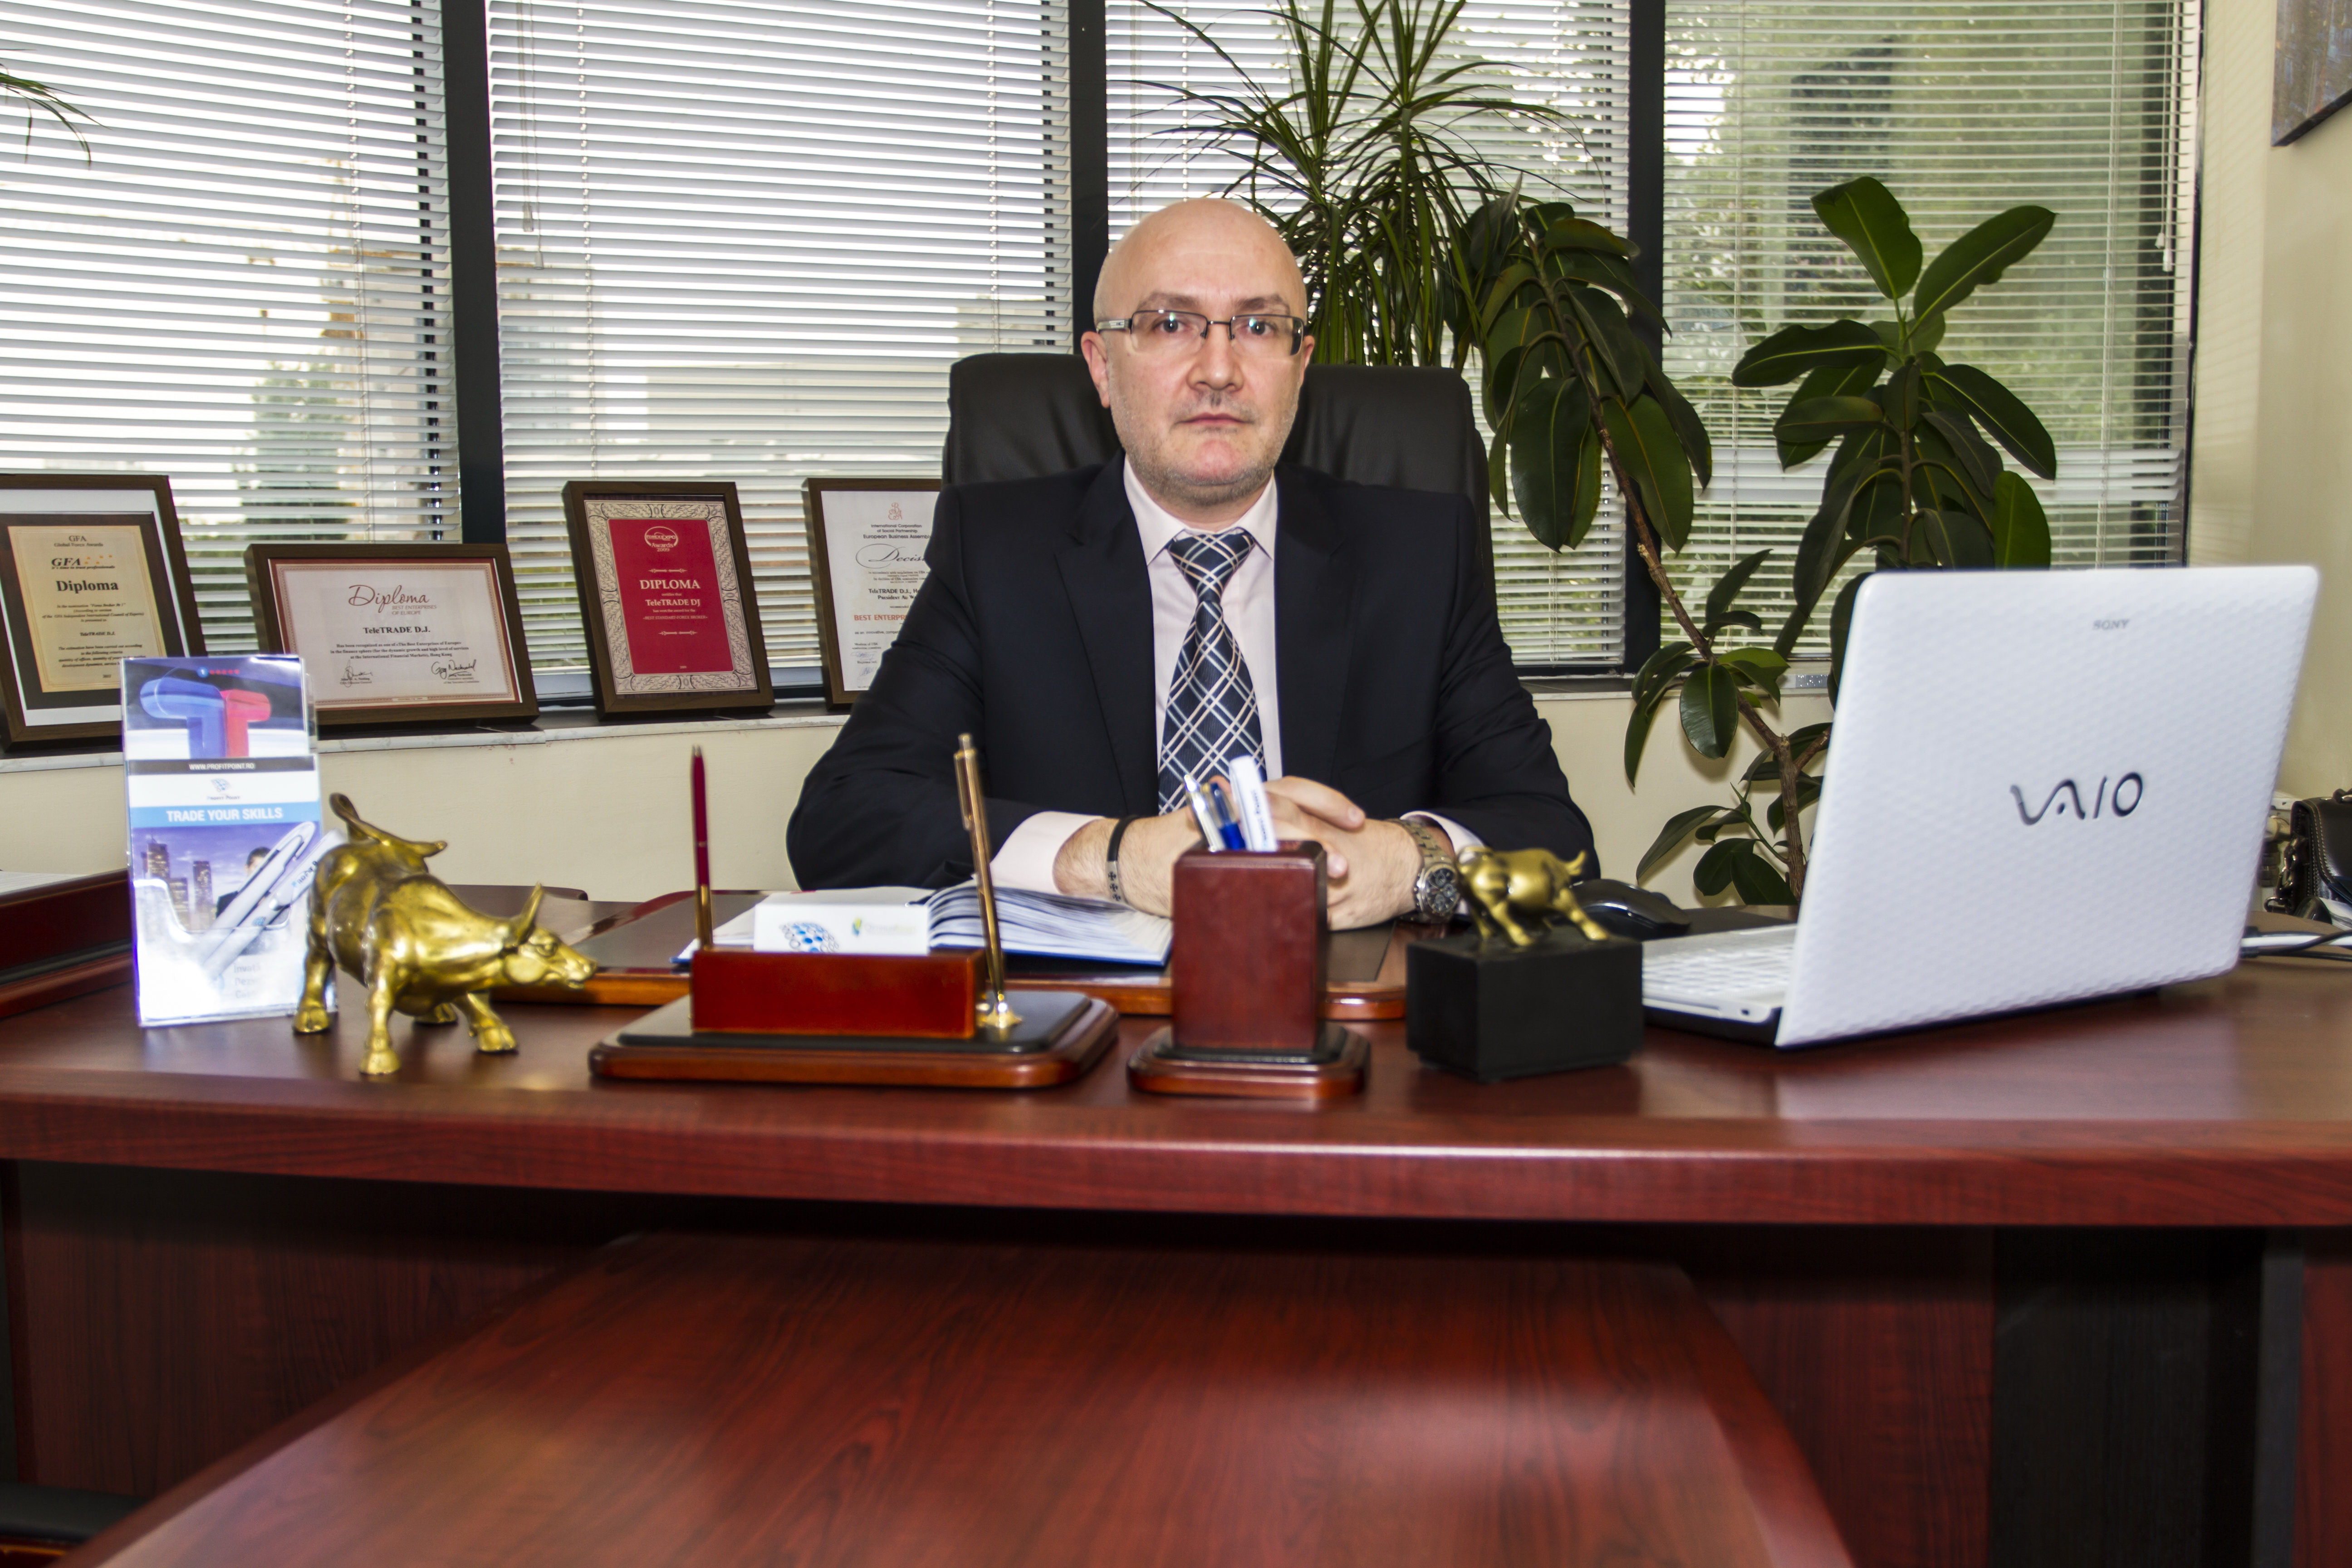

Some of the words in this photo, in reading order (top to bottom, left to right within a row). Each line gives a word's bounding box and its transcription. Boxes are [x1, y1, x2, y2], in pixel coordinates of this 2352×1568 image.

[51, 558, 81, 566] GFA
[56, 580, 119, 594] Diploma
[639, 579, 701, 589] DIPLOMA
[348, 584, 429, 613] Diploma
[2092, 619, 2130, 630] SONY
[2010, 772, 2143, 826] VAIO
[166, 810, 205, 822] TRADE
[207, 808, 240, 821] YOUR
[242, 807, 283, 820] SKILLS
